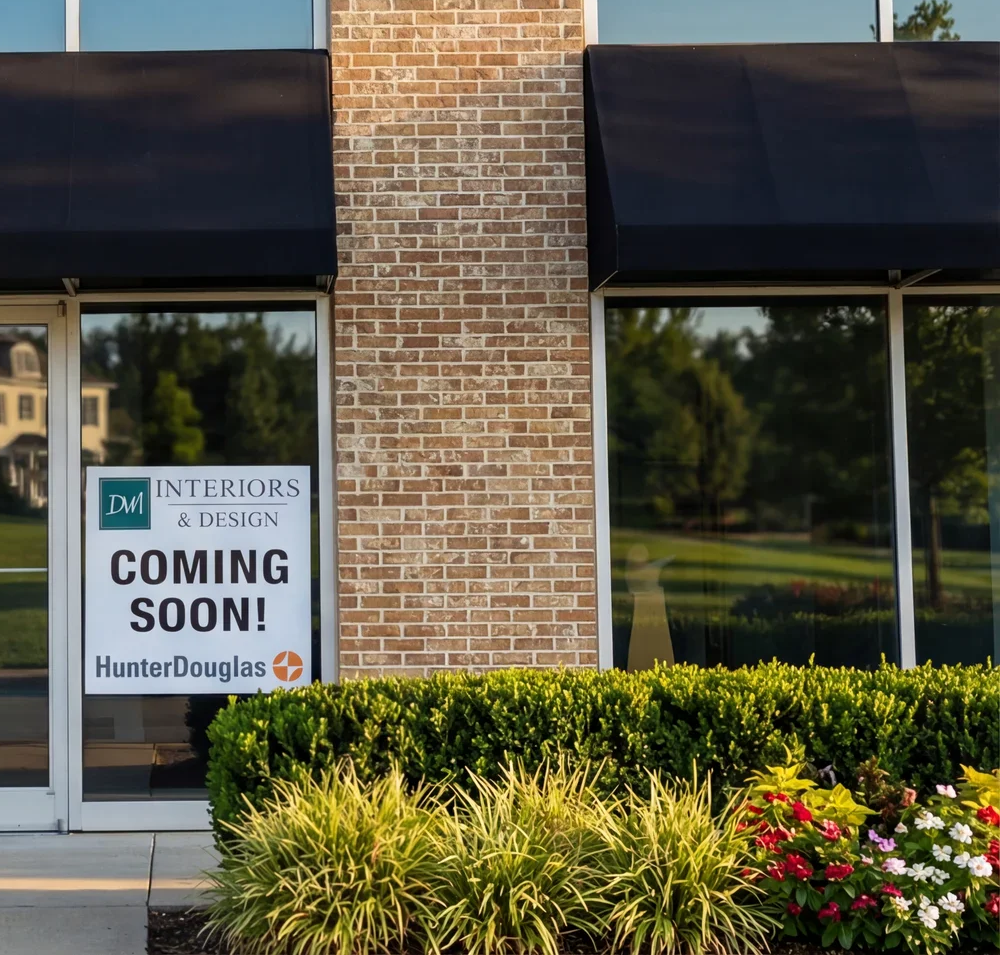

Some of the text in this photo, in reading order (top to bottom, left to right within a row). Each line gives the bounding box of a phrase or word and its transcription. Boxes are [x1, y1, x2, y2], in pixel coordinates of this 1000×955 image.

[156, 478, 301, 498] INTERIORS
[177, 511, 279, 528] & DESIGN
[110, 549, 289, 586] COMING
[130, 597, 266, 633] SOON!
[95, 655, 267, 683] HunterDouglas
